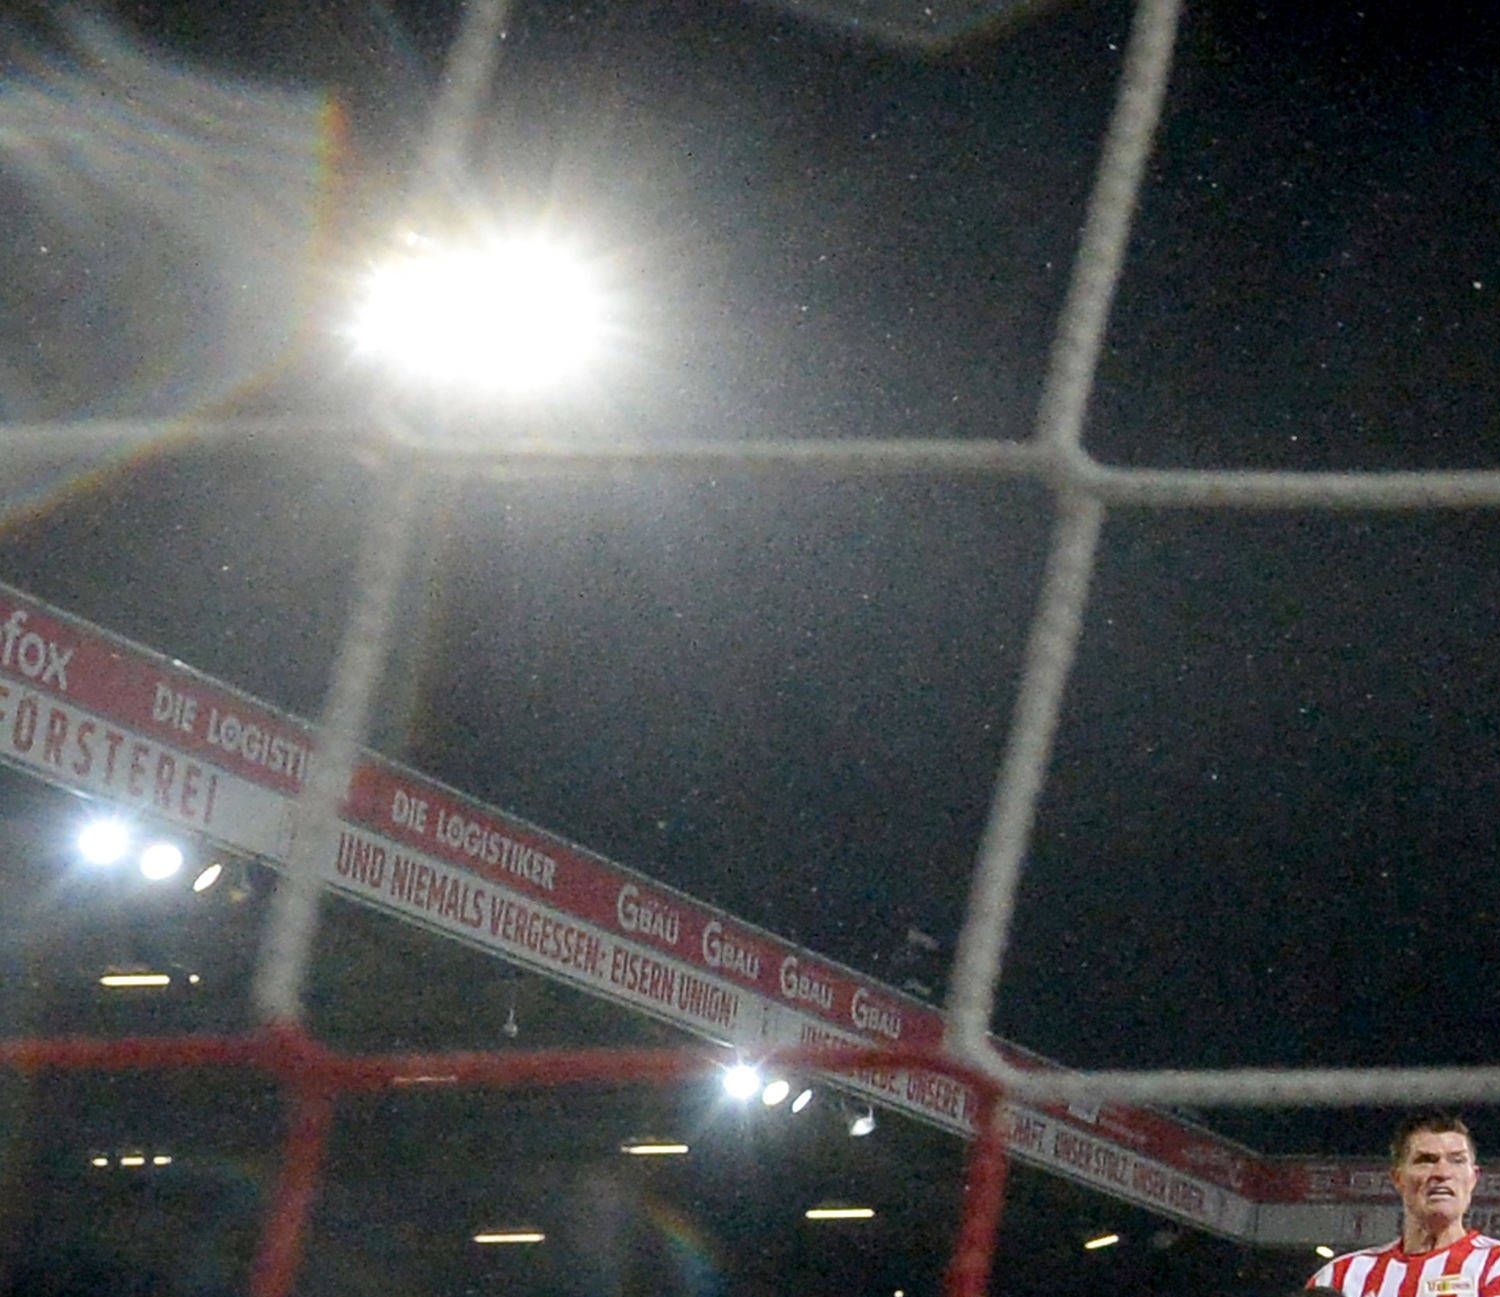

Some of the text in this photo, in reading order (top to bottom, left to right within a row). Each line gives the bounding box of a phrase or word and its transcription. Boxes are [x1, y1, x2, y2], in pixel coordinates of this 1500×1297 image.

[153, 682, 308, 783] DIE LOGISTI
[392, 789, 557, 891] DIE LOGISTIKER
[336, 832, 386, 888] UND
[391, 852, 486, 929] NIEMALS
[490, 897, 604, 978] VERGESSEN:
[611, 947, 677, 1009] EISERN
